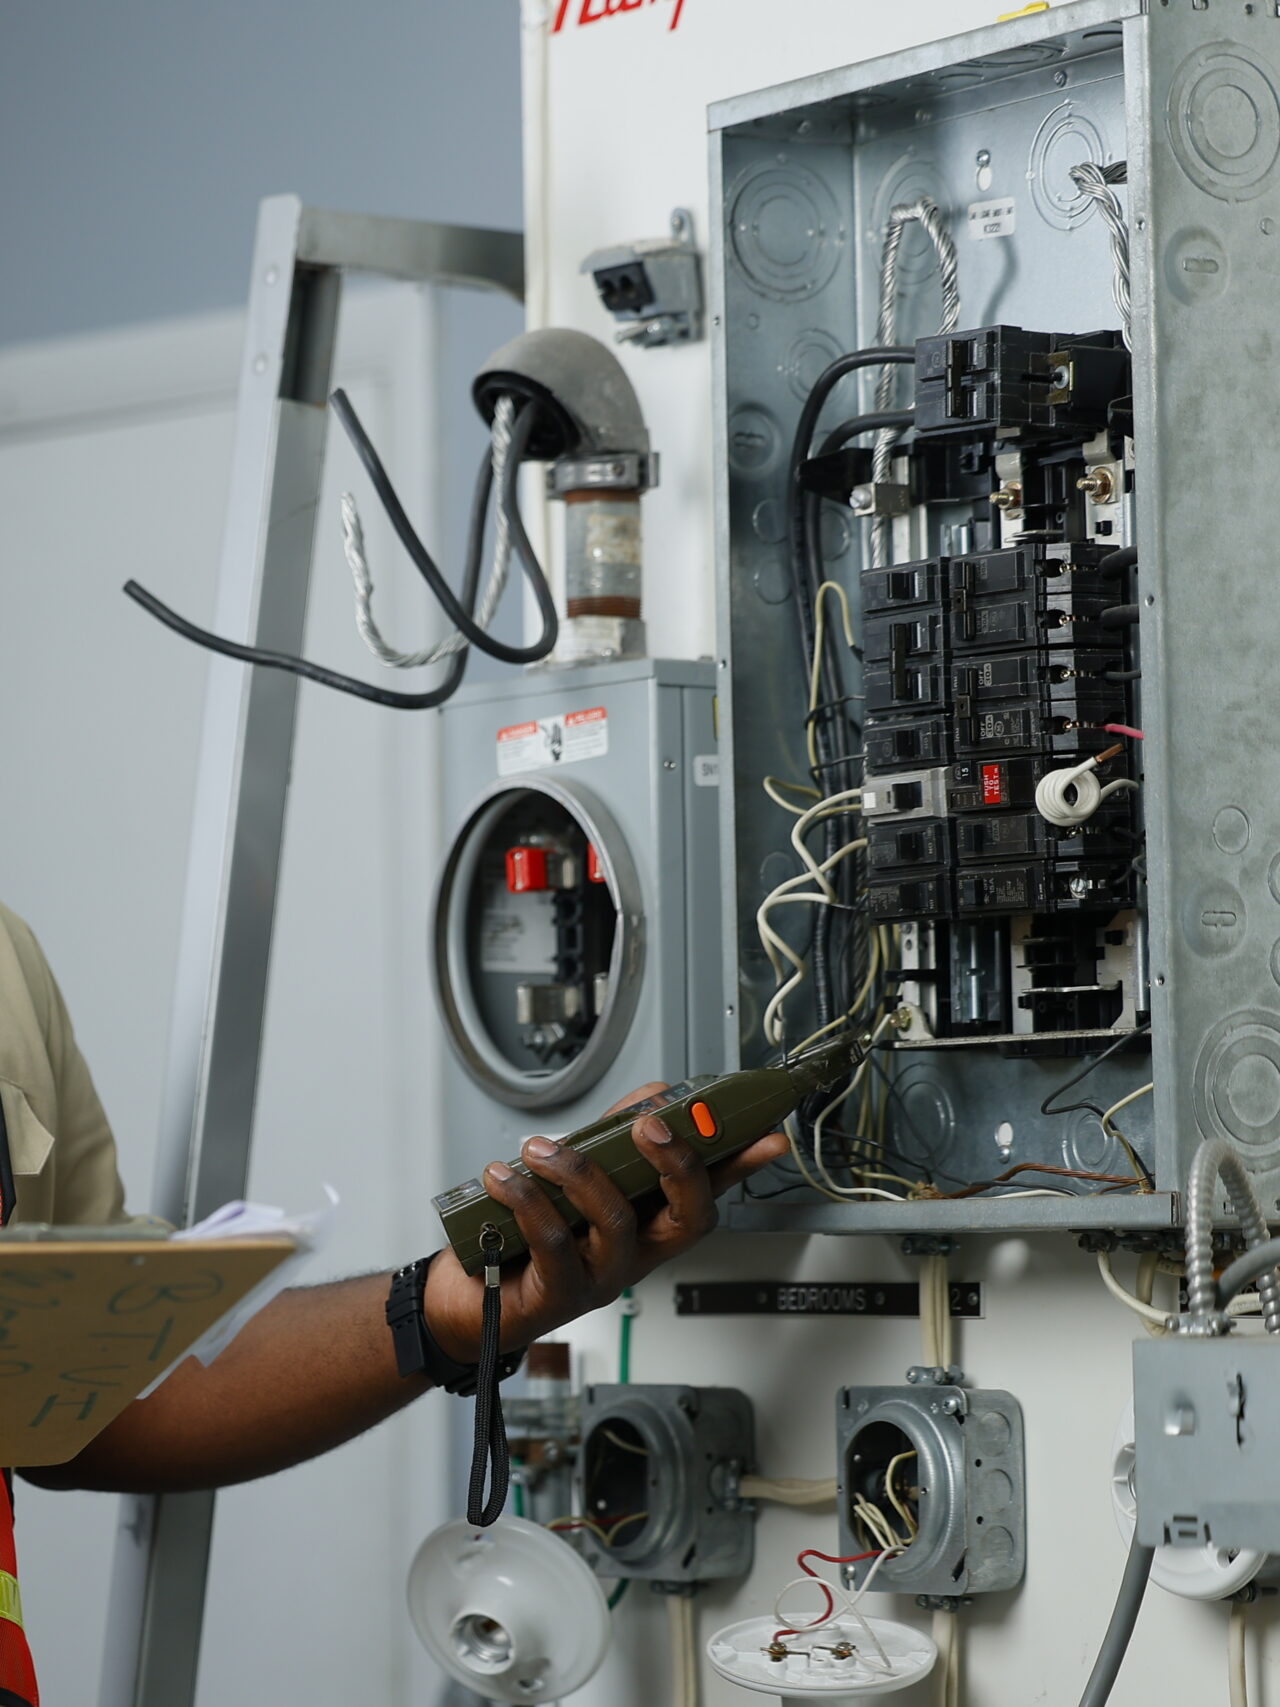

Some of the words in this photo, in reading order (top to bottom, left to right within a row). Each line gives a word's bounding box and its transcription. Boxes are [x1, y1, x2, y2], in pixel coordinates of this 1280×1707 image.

[961, 766, 969, 778] 15
[777, 1287, 866, 1311] BEDROOMS
[951, 1290, 963, 1311] 2
